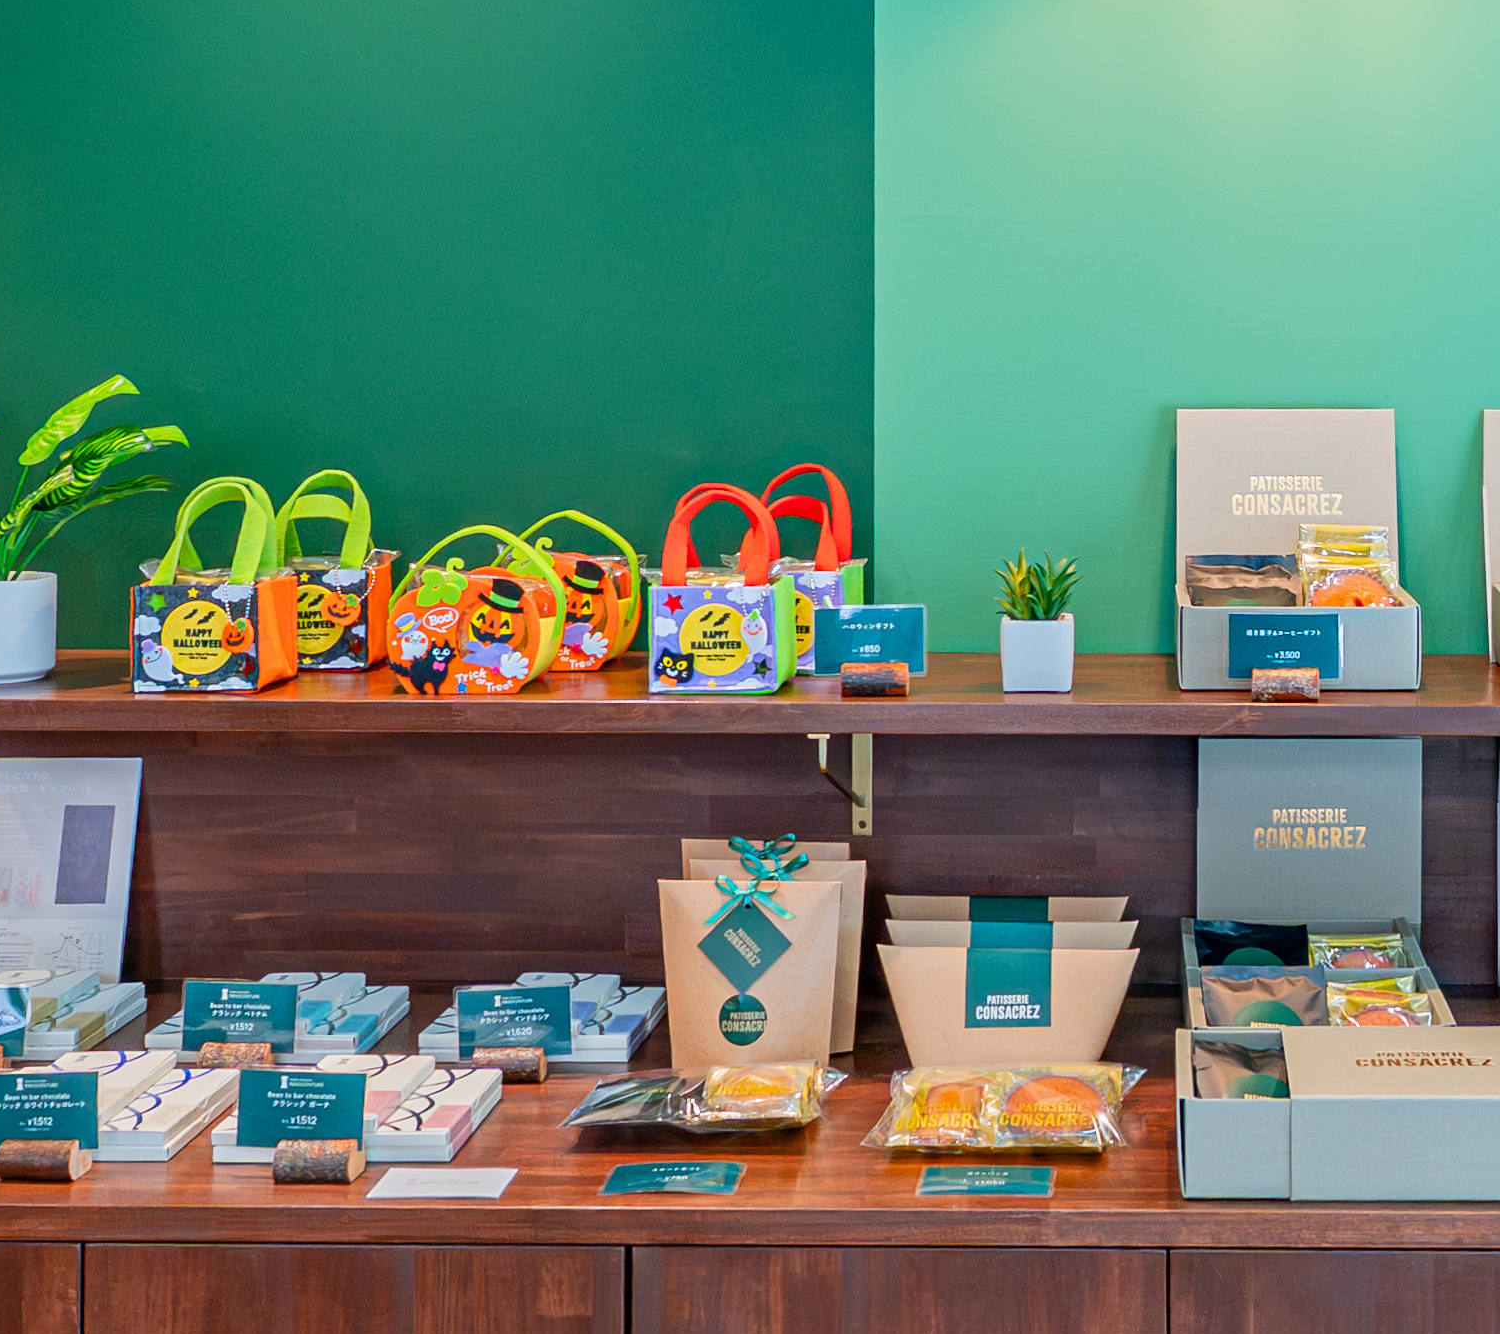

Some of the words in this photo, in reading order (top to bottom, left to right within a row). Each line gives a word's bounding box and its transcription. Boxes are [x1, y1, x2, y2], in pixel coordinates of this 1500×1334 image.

[1249, 474, 1324, 492] PATISSERIE
[1231, 492, 1343, 516] CONSACREZ
[428, 611, 454, 626] Boo!
[186, 629, 212, 637] HAPPY
[702, 631, 729, 639] HAPPY
[691, 641, 741, 650] HALLOWEEN
[859, 644, 881, 653] ¥850
[569, 657, 595, 669] Treat
[455, 668, 487, 684] Trick
[485, 680, 514, 692] Treat
[1272, 807, 1348, 824] PATISSERIE
[1253, 824, 1367, 850] CONSACREZ
[724, 928, 762, 968] CONSACREZ
[986, 994, 1030, 1005] PATISSERIE
[976, 1004, 1041, 1021] CONSACREZ
[1355, 1057, 1494, 1067] CONSACREZ
[27, 1117, 53, 1126] ¥1,512
[290, 1115, 318, 1125] ¥1,512
